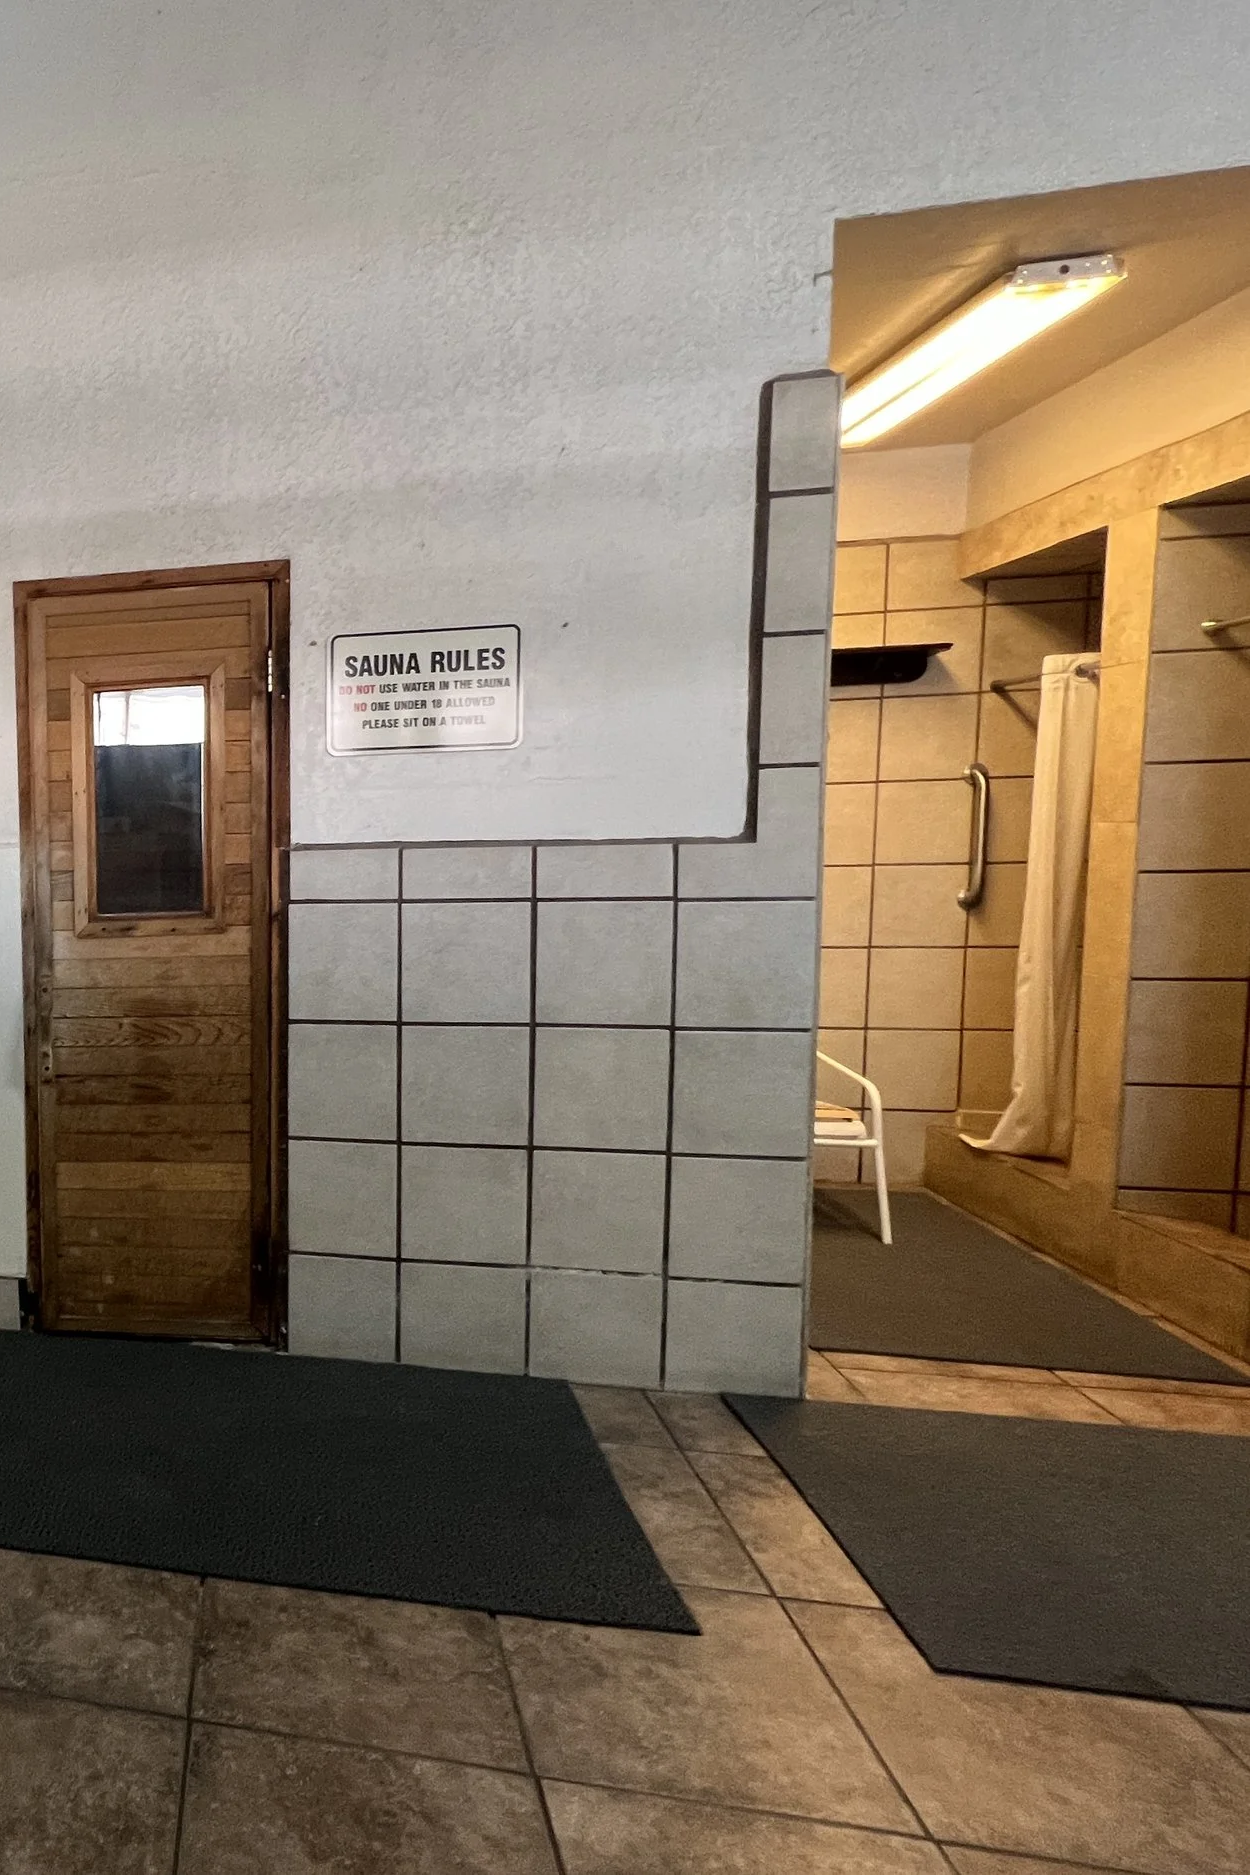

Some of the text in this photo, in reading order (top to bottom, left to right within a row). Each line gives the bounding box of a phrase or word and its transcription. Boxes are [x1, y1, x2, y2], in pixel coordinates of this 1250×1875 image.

[344, 647, 506, 678] SAUNA RULES
[338, 677, 511, 695] DO NOT USE WATER IN THE SAUNA
[353, 696, 495, 712] NO ONE UNDER 18 ALLOWED
[362, 715, 486, 729] PLEASE SIT ON A TOWEL
